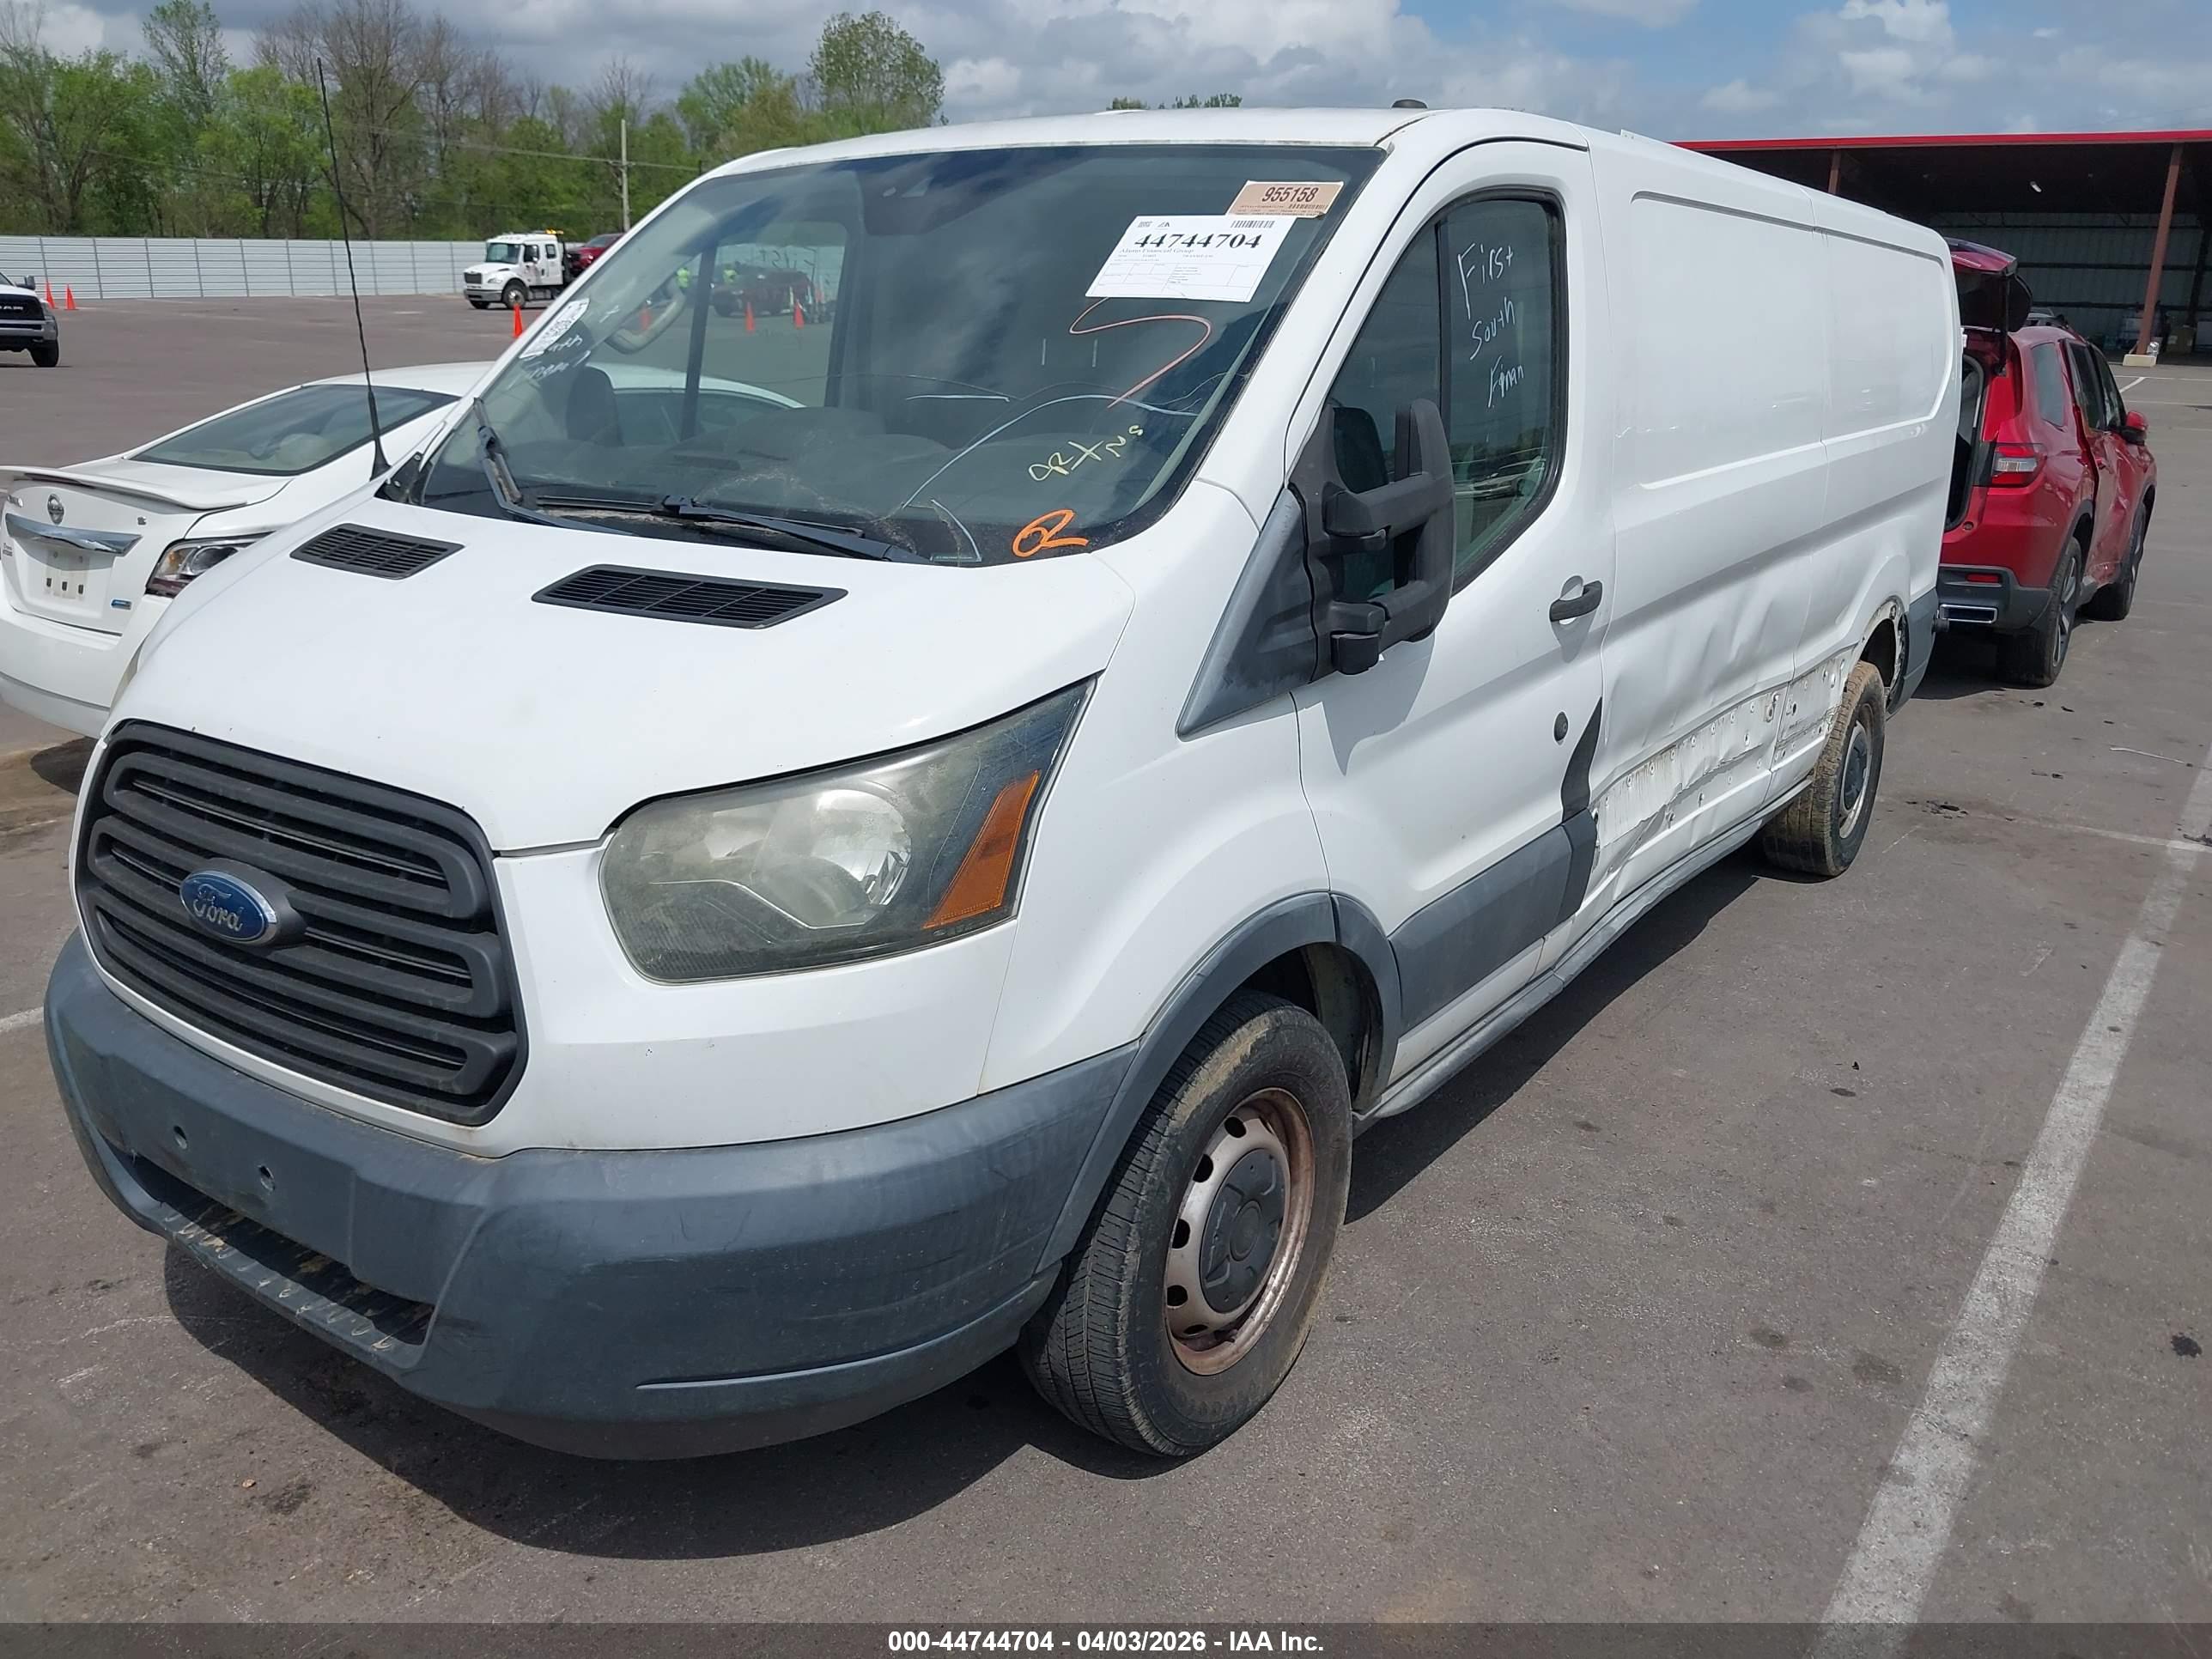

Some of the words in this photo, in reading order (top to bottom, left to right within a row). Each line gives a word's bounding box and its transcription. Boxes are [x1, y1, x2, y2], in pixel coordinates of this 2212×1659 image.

[1261, 186, 1320, 203] 955158
[1133, 233, 1263, 248] 44744704
[191, 882, 245, 933] Ford
